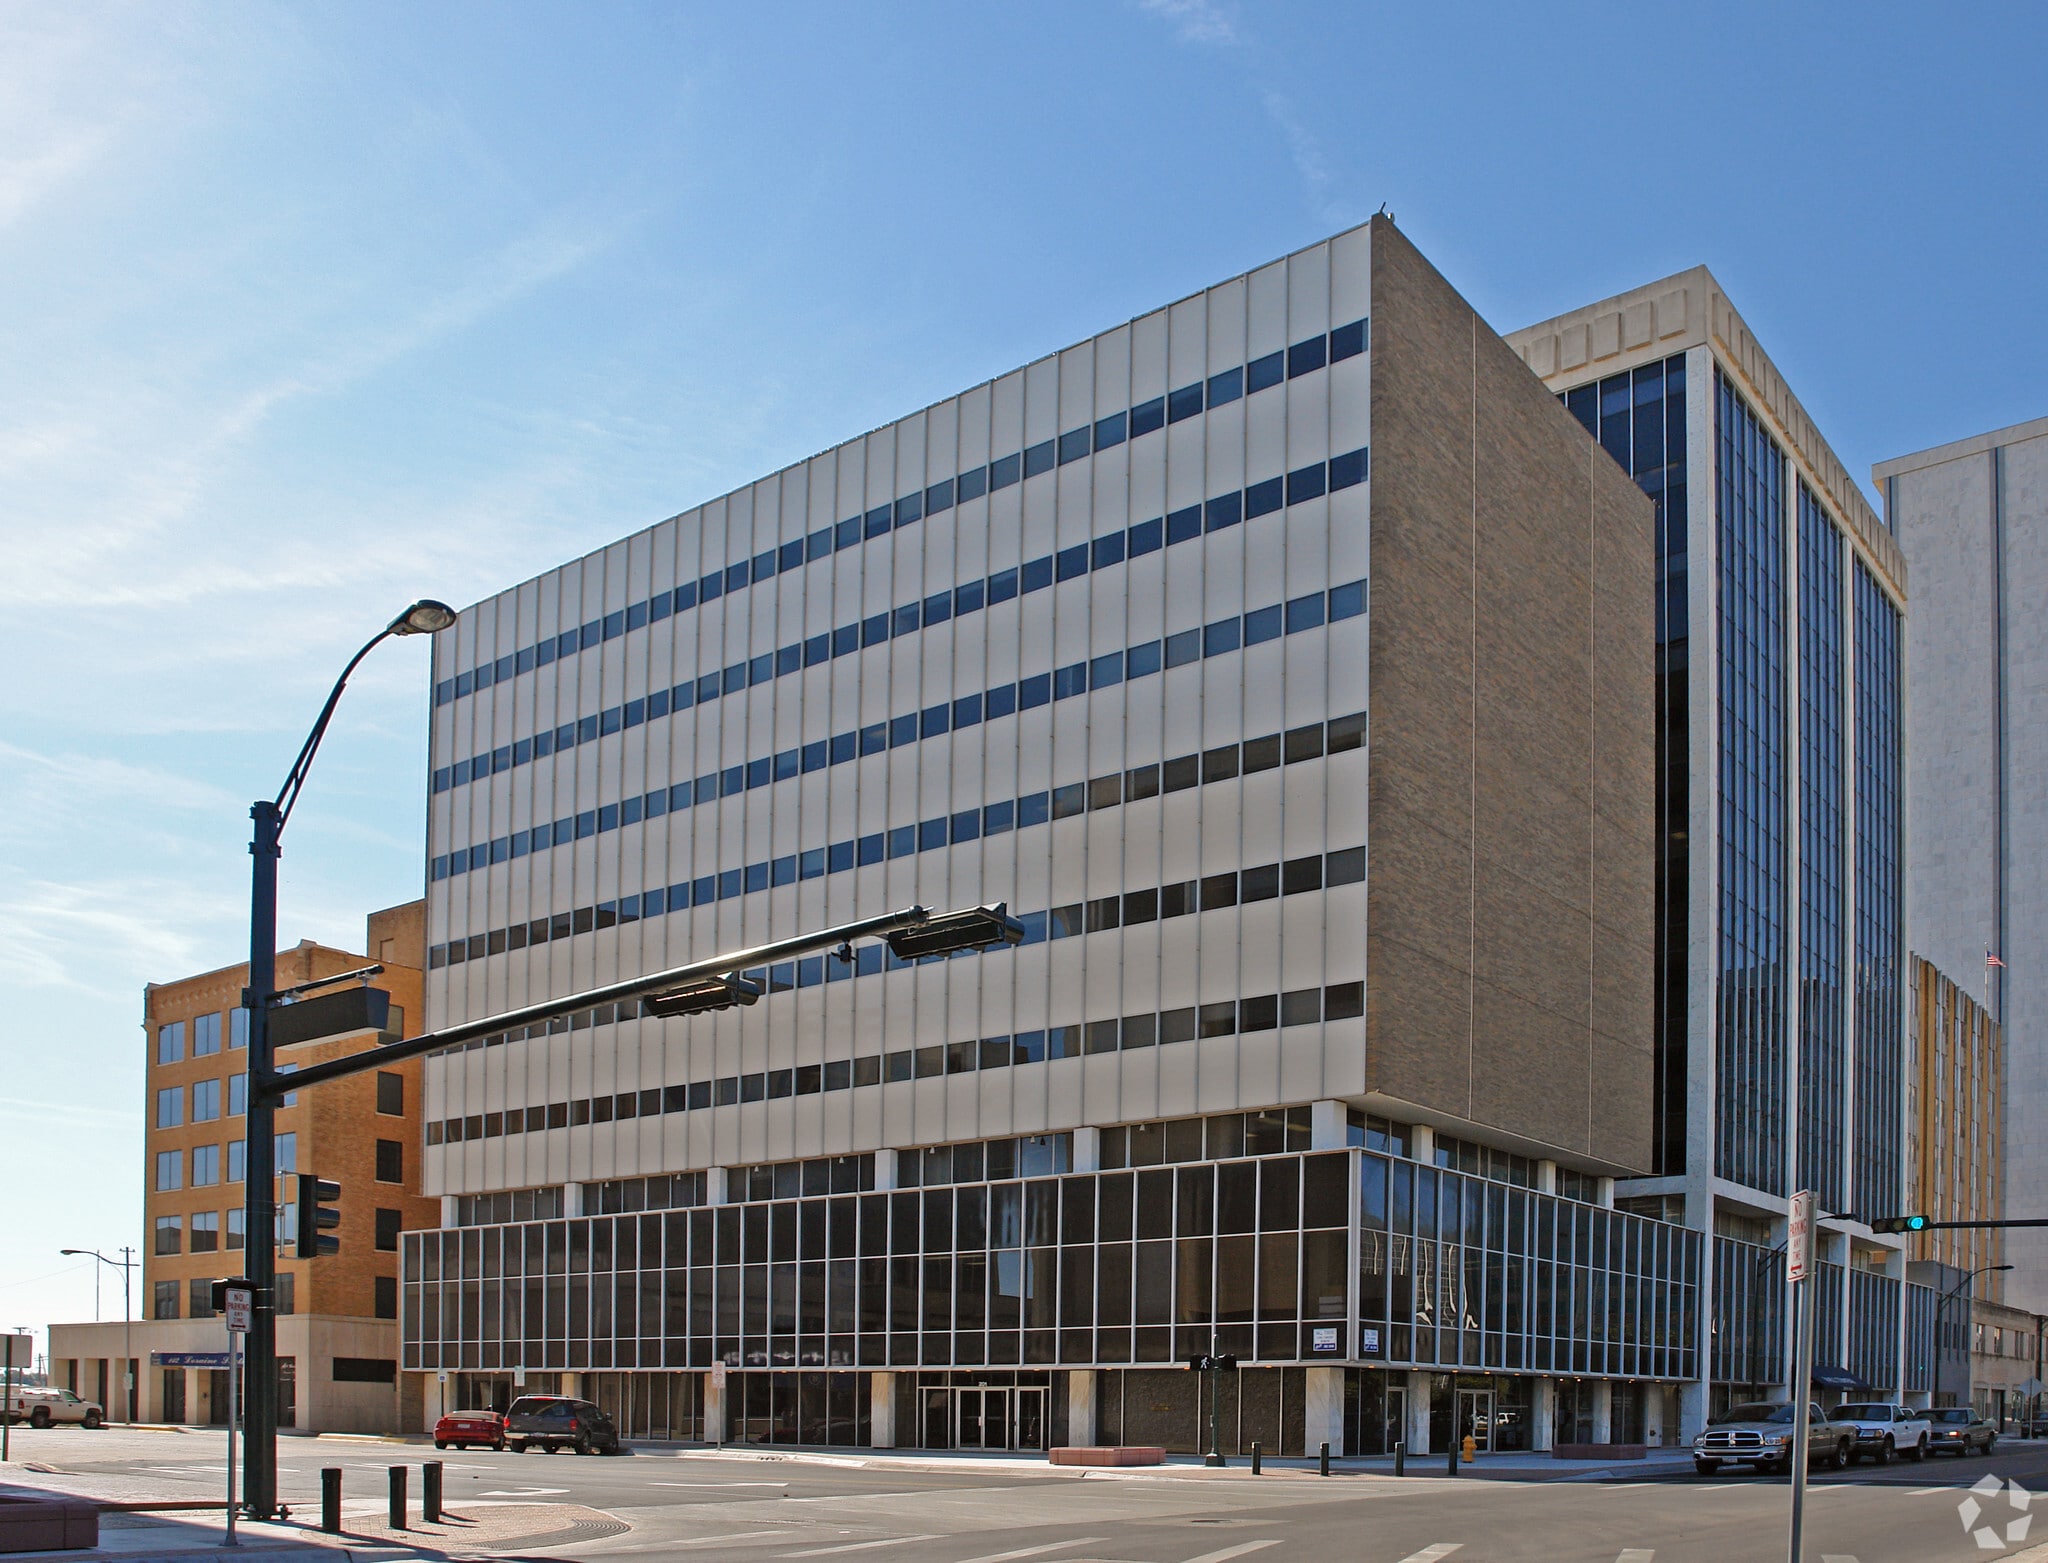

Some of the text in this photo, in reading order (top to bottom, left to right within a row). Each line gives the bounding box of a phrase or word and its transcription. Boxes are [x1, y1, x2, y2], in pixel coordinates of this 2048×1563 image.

[1794, 1202, 1802, 1217] NO
[1790, 1219, 1806, 1236] PARKING
[1793, 1237, 1802, 1249] ANY
[1792, 1249, 1801, 1262] TIME
[234, 1294, 244, 1302] NO
[227, 1303, 250, 1311] PARKING
[183, 1356, 218, 1364] Loraine
